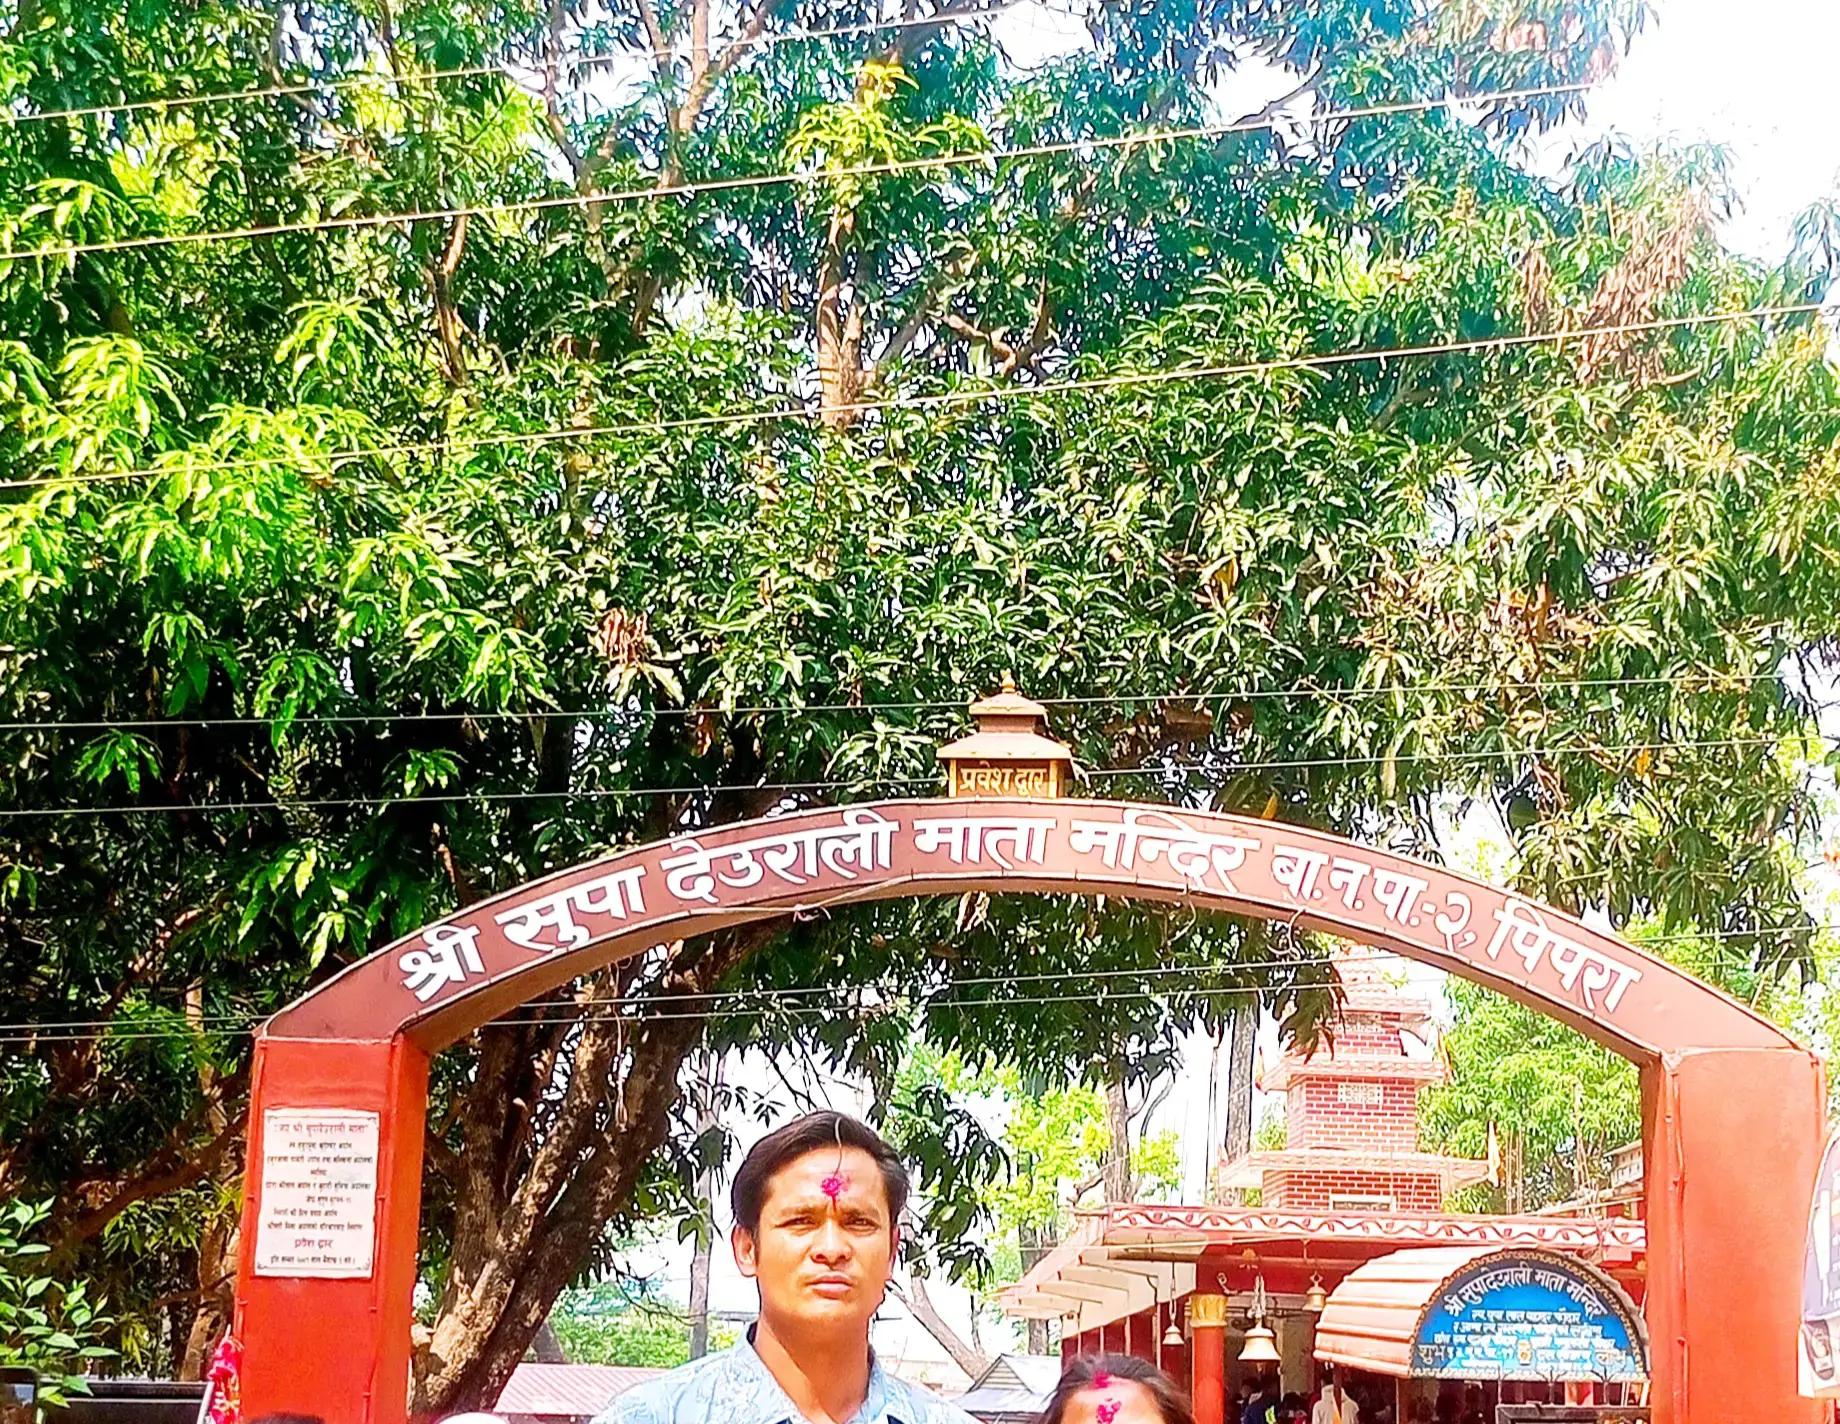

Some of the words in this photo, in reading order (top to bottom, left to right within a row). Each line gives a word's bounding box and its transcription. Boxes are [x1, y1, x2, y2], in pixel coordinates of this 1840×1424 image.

[960, 761, 1014, 795] प्रवेश
[1015, 768, 1047, 796] द्वार
[399, 924, 485, 1002] श्री
[494, 866, 646, 951] सुपा
[660, 808, 899, 903] देउराली
[912, 818, 1056, 870] माता
[1069, 809, 1261, 894] मन्दिर
[1486, 896, 1643, 1014] पिपरा
[1444, 1294, 1466, 1317] श्री
[1535, 1269, 1568, 1293] माता
[1566, 1283, 1608, 1321] मन्दिर
